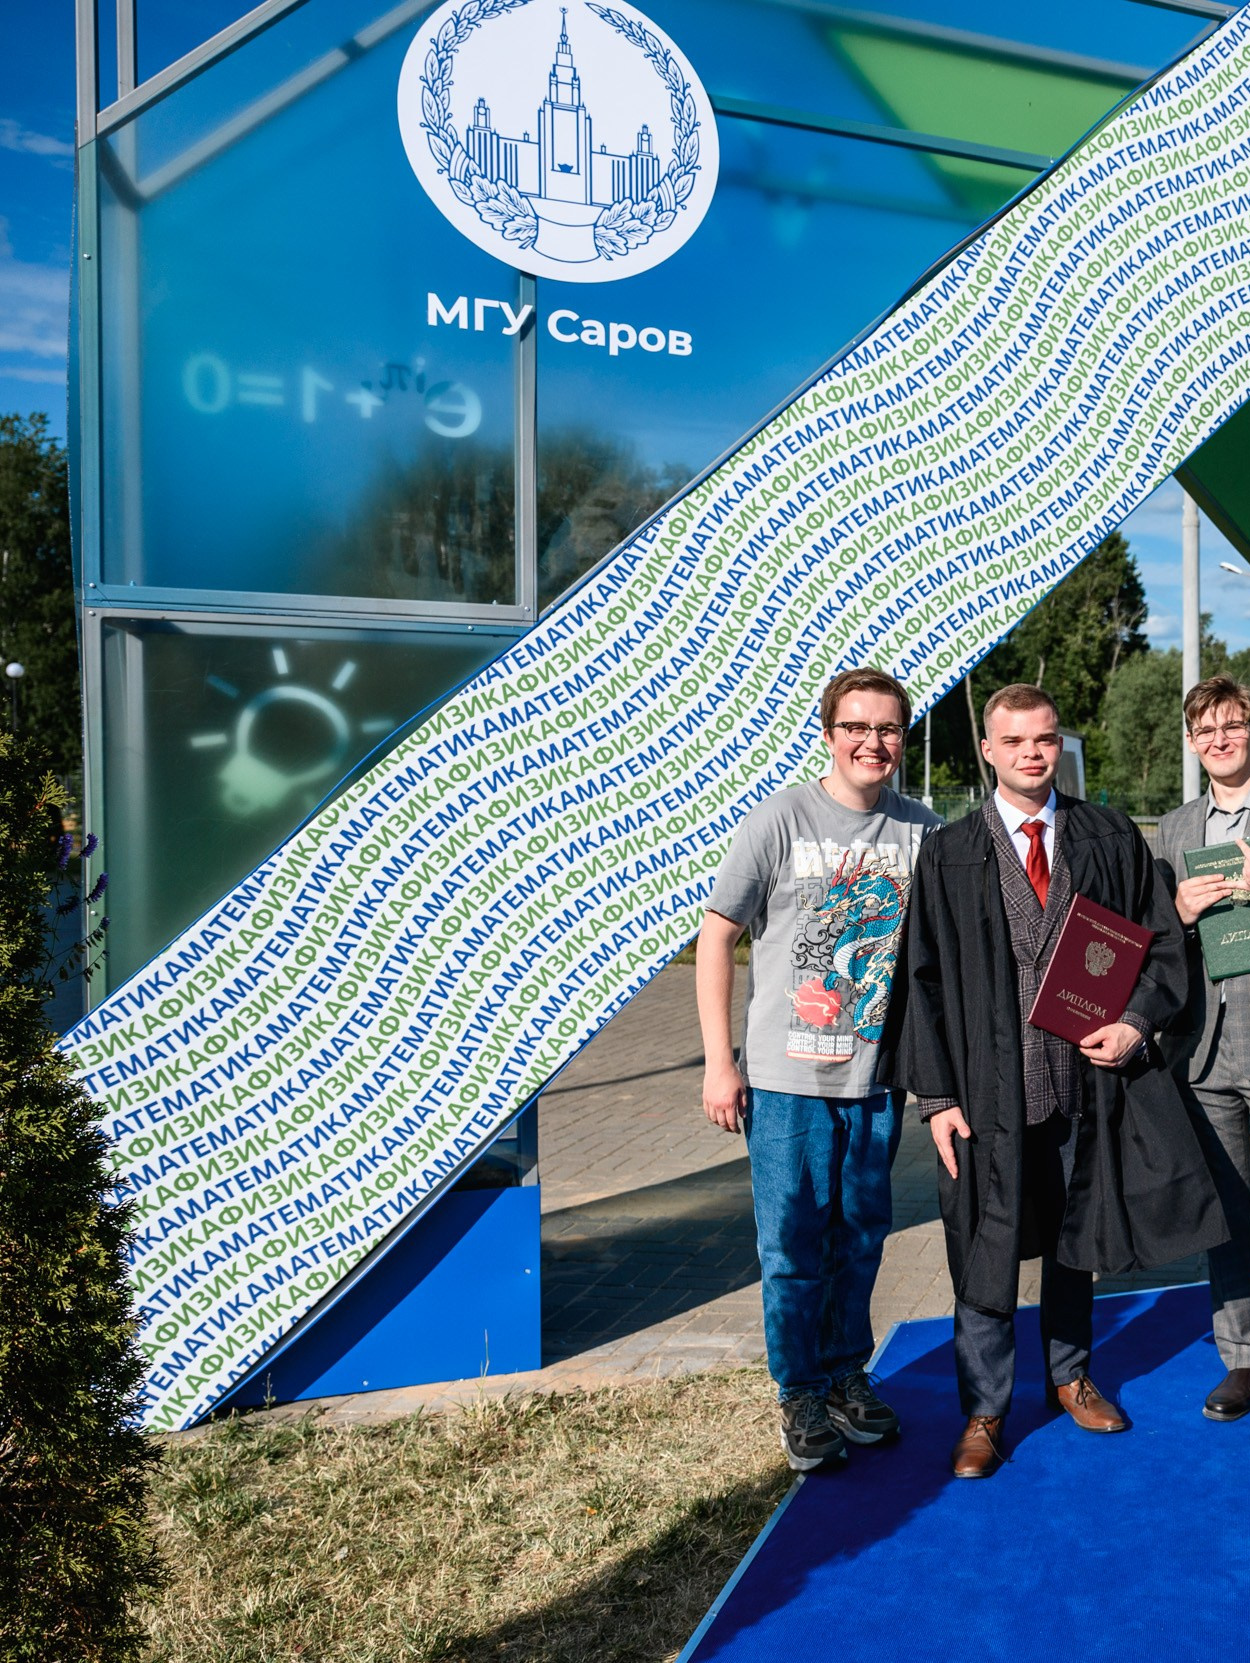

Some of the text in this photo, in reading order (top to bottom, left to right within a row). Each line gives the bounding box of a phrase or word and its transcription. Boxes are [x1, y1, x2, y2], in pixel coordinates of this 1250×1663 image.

[427, 292, 693, 356] МГУ Саров
[1056, 988, 1108, 1020] ДИПЛОМ
